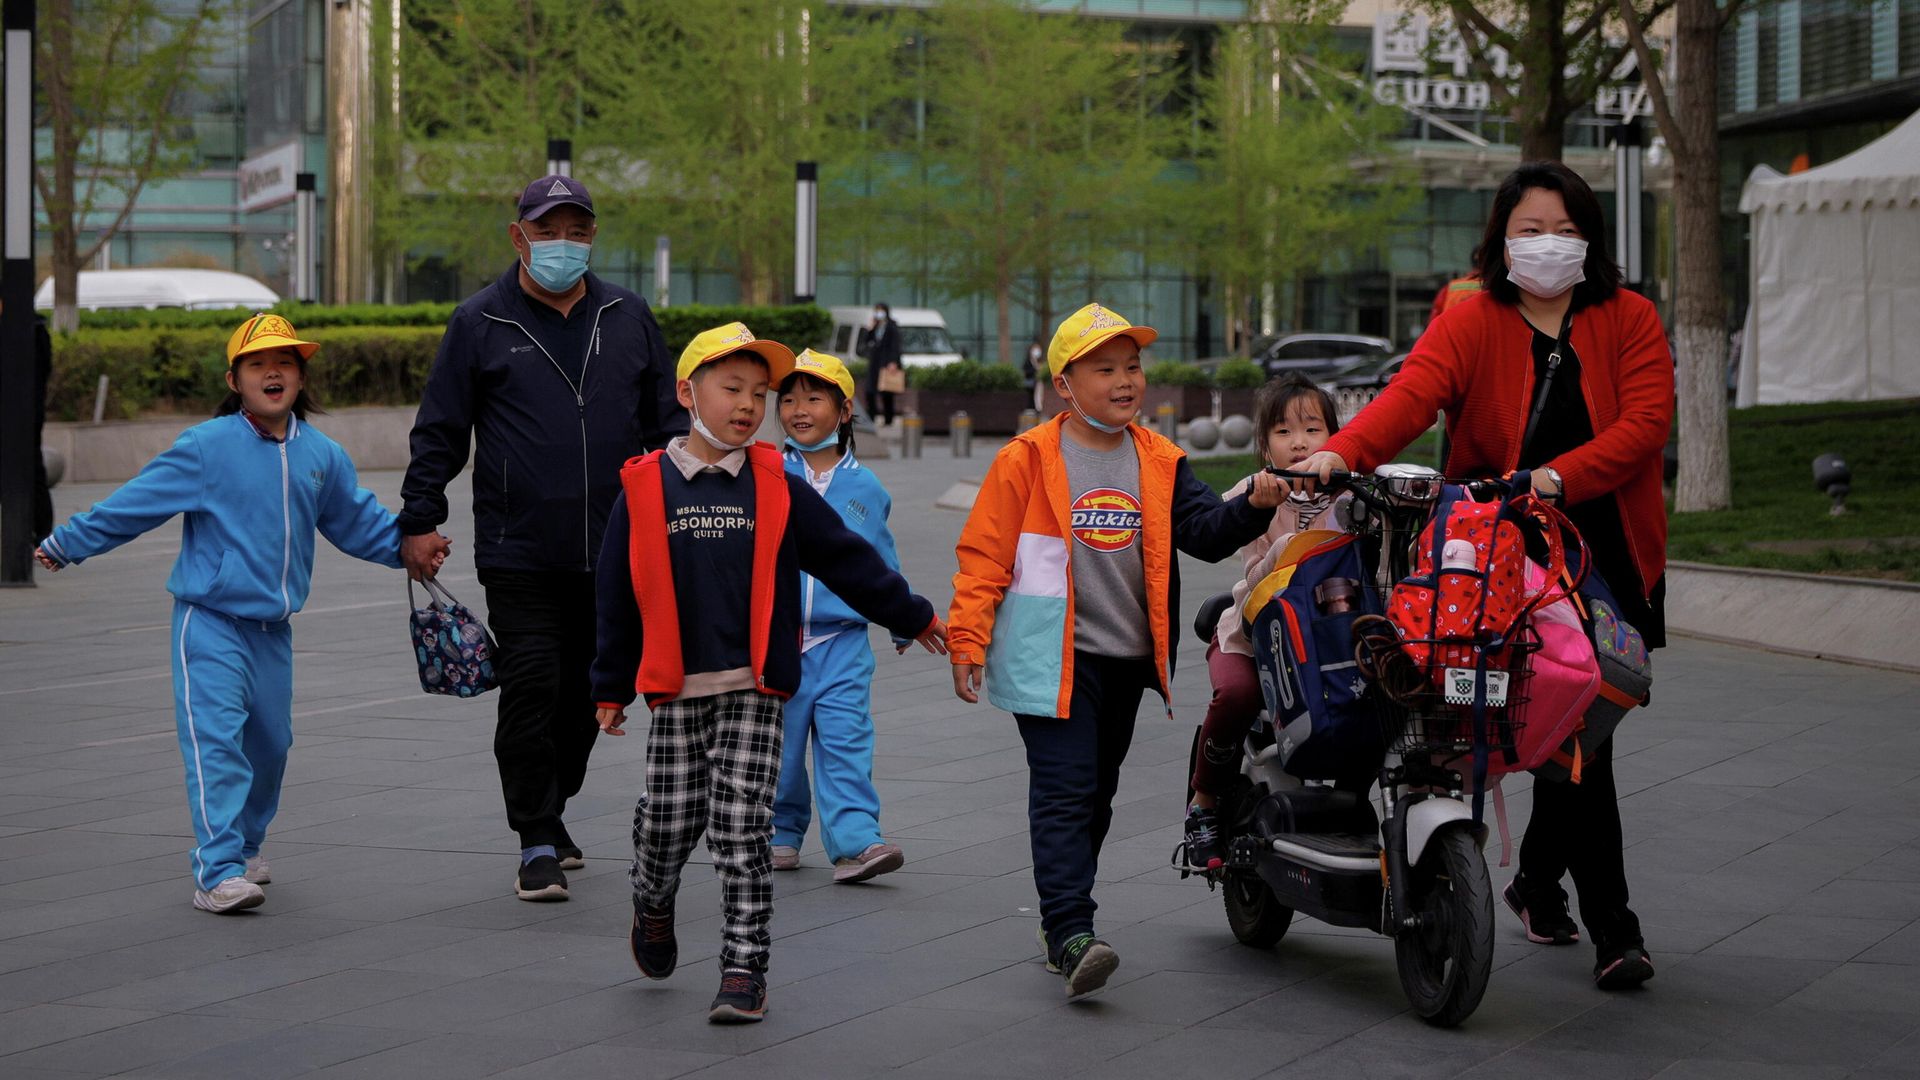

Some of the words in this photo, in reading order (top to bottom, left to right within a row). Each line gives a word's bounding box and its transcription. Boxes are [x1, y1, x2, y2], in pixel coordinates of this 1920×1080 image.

[1374, 78, 1490, 109] GUOH
[677, 506, 708, 515] MSALL
[710, 506, 744, 514] TOWNS
[1071, 512, 1142, 527] Dickies
[693, 530, 725, 538] QUITE
